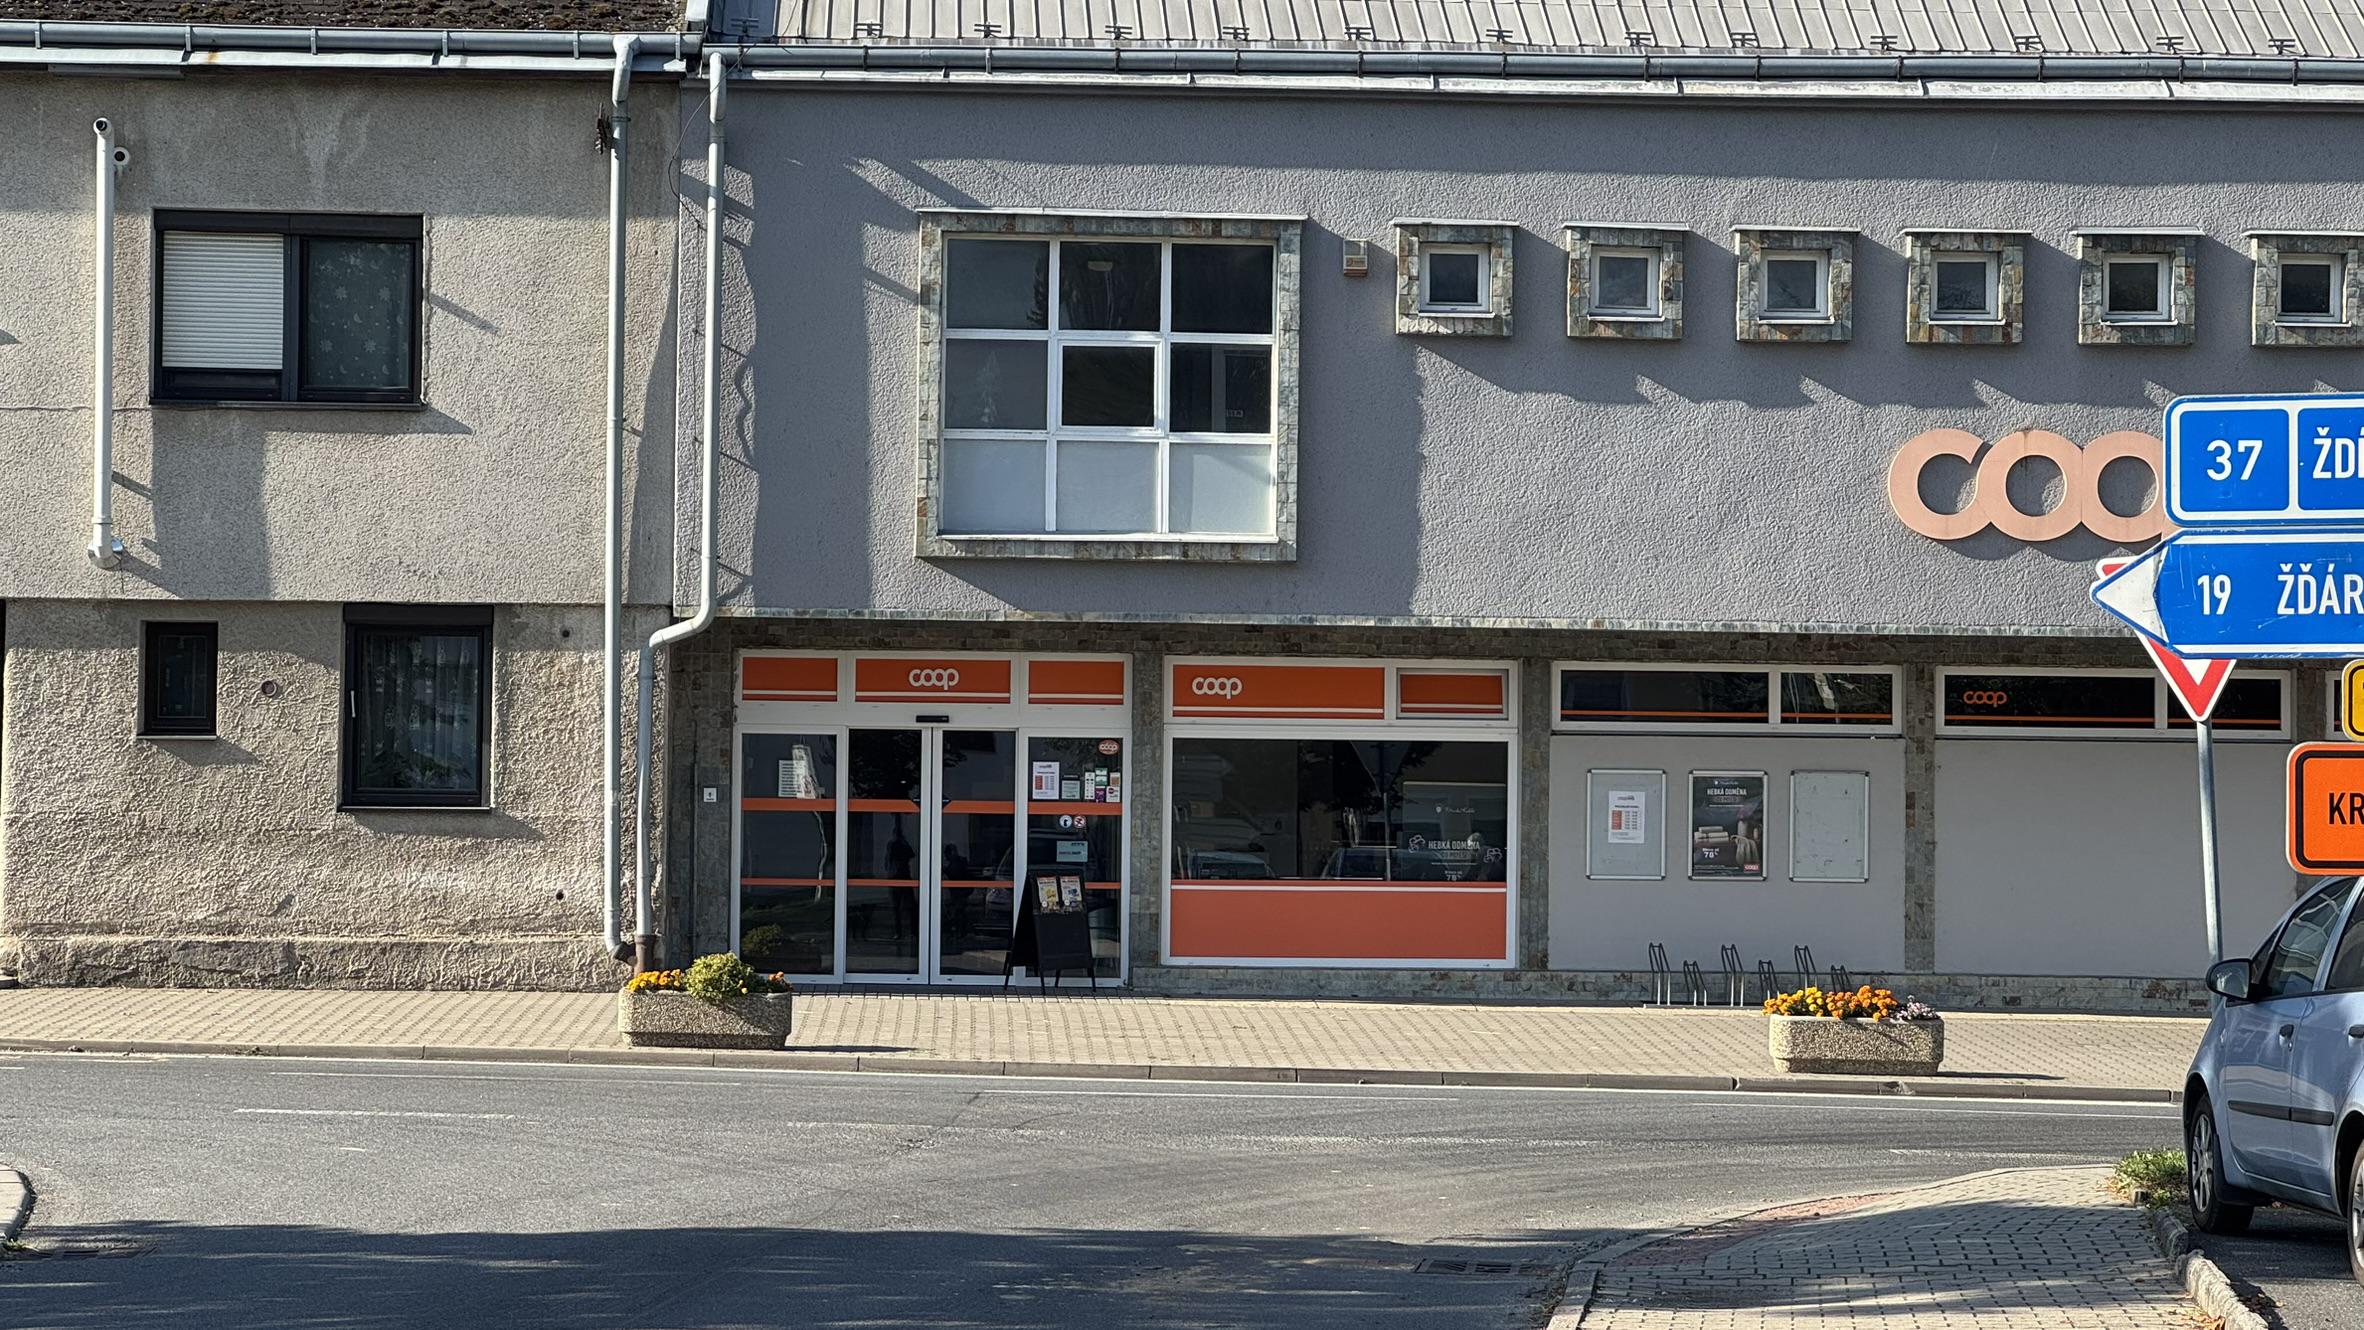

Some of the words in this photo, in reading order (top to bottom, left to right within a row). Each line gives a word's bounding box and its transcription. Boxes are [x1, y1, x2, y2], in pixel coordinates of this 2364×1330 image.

[2206, 439, 2263, 481] 37
[1888, 428, 2180, 544] coo
[2197, 574, 2231, 616] 19
[2277, 563, 2364, 615] ŽĎÁR
[908, 668, 960, 691] coop
[1191, 676, 1243, 700] coop
[1963, 691, 2008, 709] coop
[2328, 792, 2364, 826] KR
